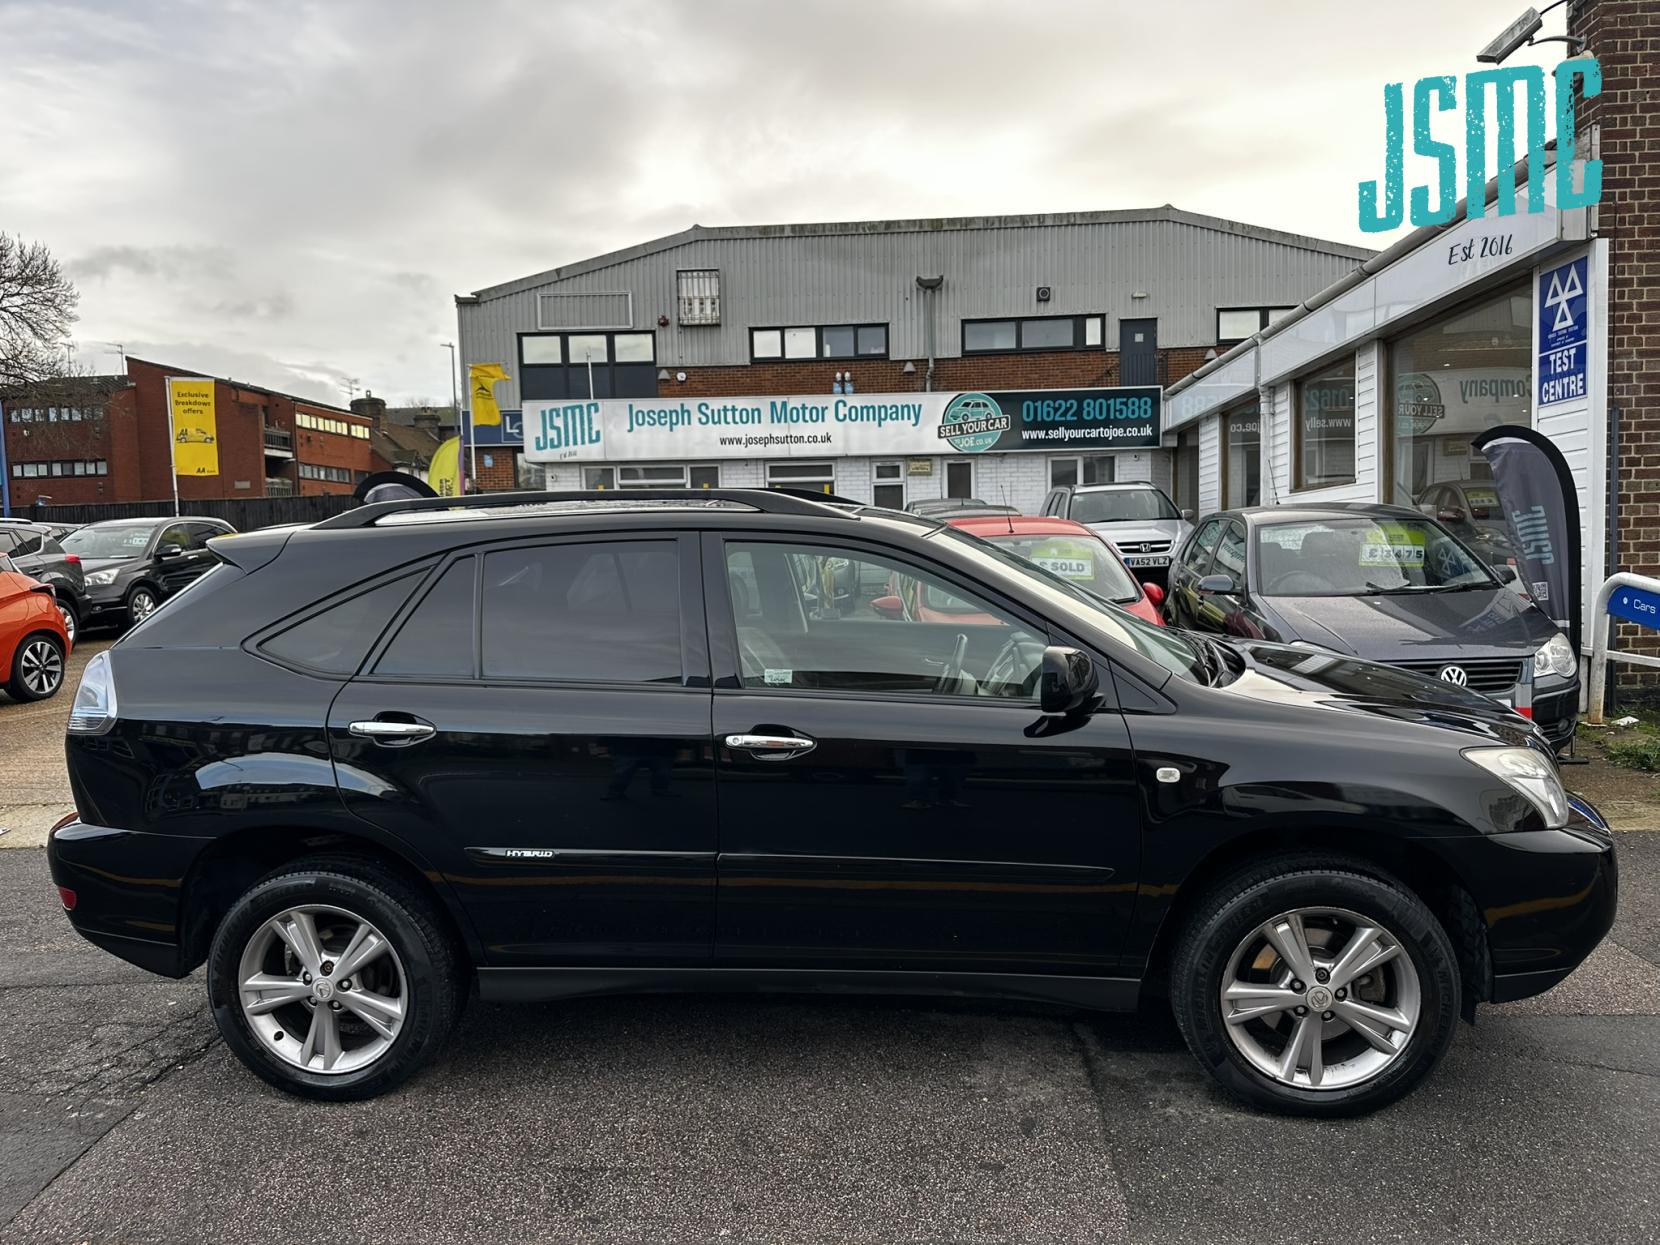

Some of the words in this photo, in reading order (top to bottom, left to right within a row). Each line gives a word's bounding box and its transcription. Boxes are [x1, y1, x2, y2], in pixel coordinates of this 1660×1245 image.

[1448, 239, 1475, 265] Est
[1480, 234, 1513, 258] 2016
[1549, 348, 1577, 374] TEST
[177, 391, 209, 399] Exclusive
[1542, 373, 1584, 403] CENTRE
[182, 407, 203, 415] offers
[628, 403, 692, 432] Joseph
[697, 402, 761, 426] Sutton
[770, 400, 828, 424] Motor
[834, 399, 922, 427] Company
[1022, 400, 1077, 422] 01622
[1082, 397, 1152, 420] 801588
[535, 402, 601, 451] JSMC
[940, 425, 960, 437] SELL
[962, 421, 987, 433] YOUR
[988, 417, 1007, 430] CAR
[1021, 424, 1153, 441] www.sellyourcartojoe.co.uk
[719, 432, 832, 448] www.josephsutton.co.uk
[1512, 505, 1555, 565] JSMC
[1051, 562, 1085, 572] SOLD
[1131, 557, 1151, 566] VA52
[1153, 556, 1168, 566] VLZ
[1633, 598, 1656, 614] Cars
[506, 850, 553, 858] HYBRID
